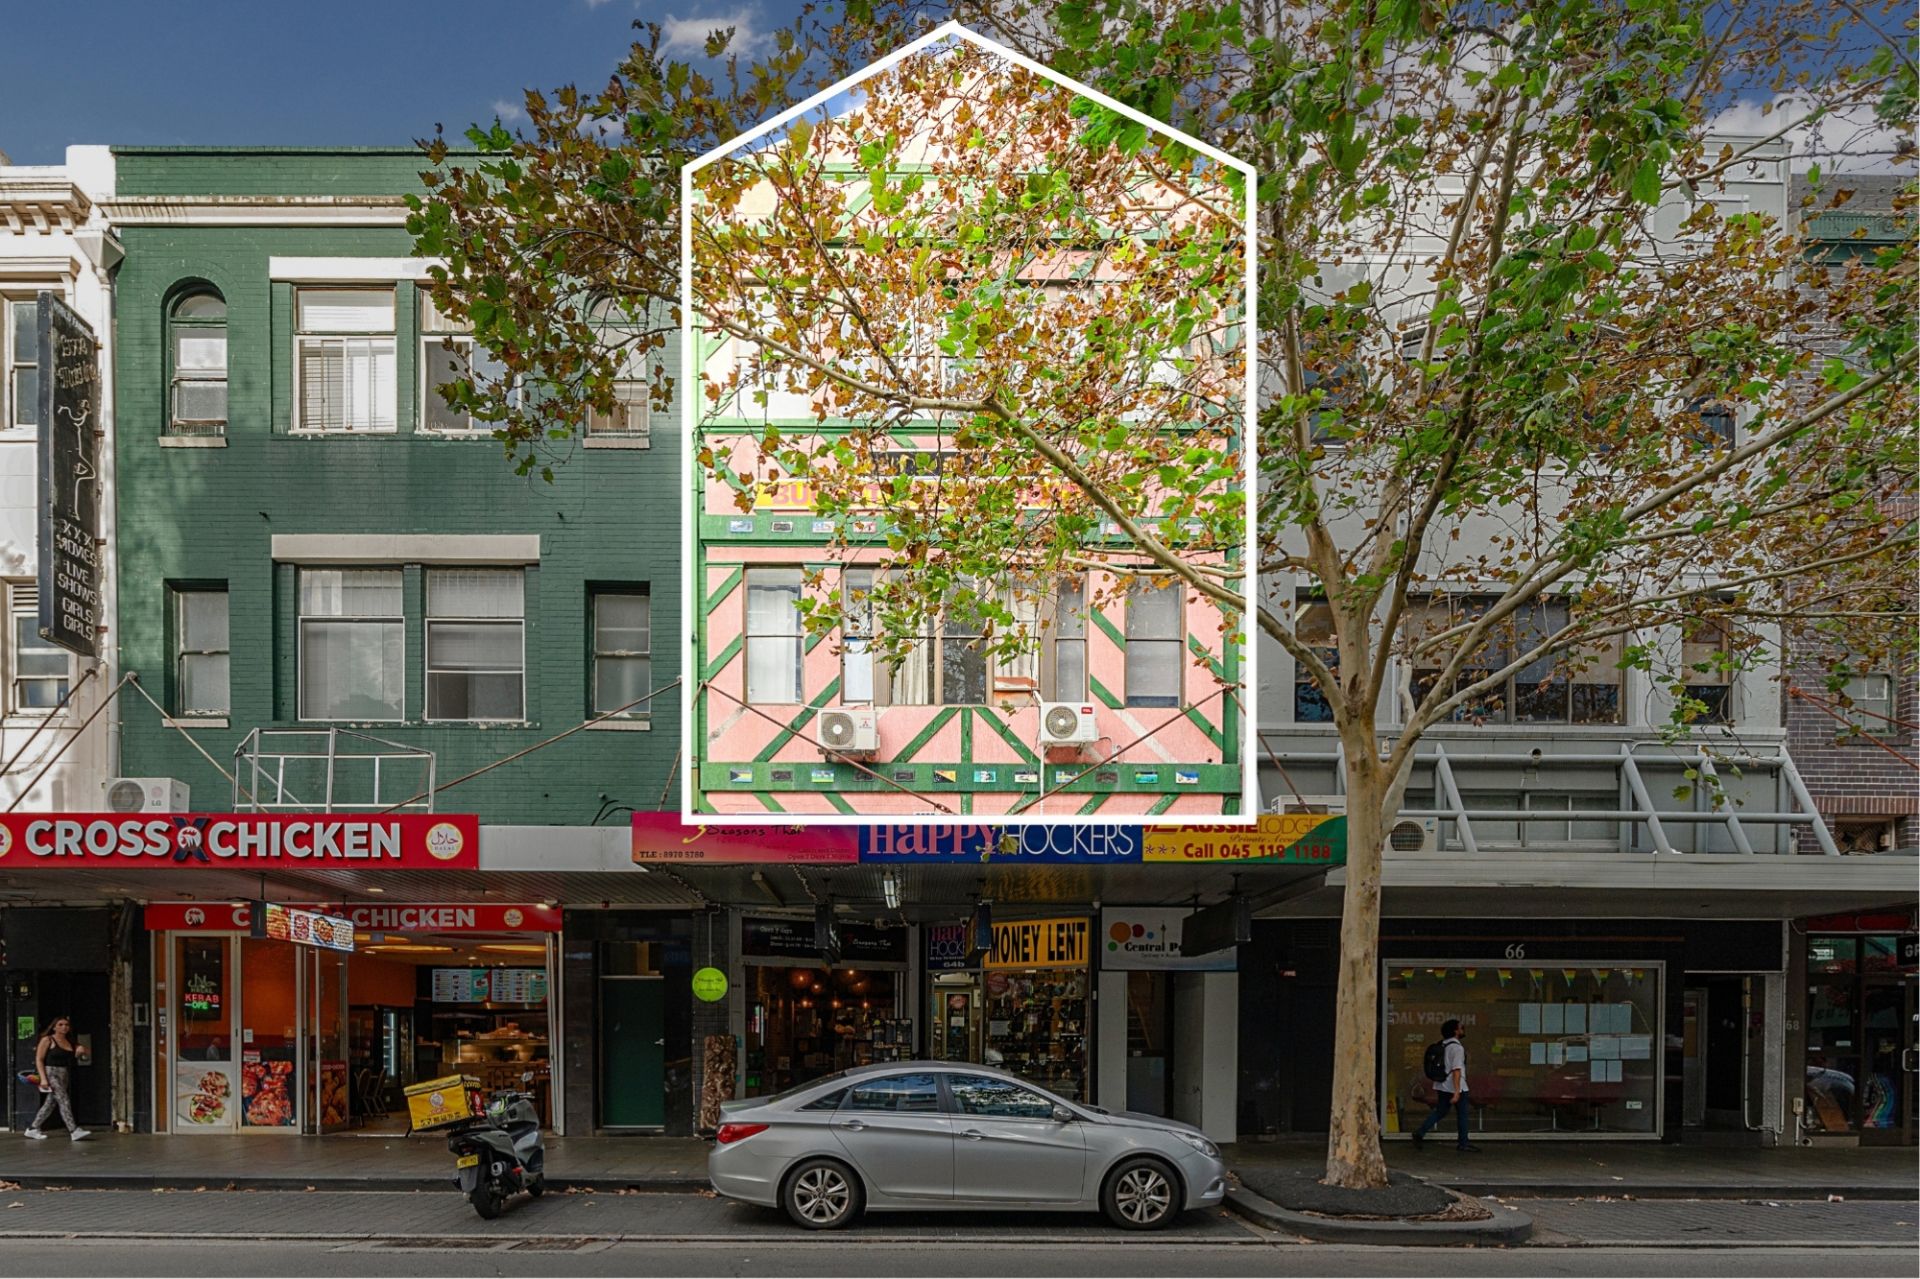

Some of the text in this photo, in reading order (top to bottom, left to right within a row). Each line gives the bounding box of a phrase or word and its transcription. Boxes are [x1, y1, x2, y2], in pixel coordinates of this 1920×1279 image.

[65, 560, 88, 585] LIVE
[57, 573, 97, 605] SHOWS
[62, 597, 94, 624] GIRLS
[63, 615, 94, 641] GIRLS
[1258, 817, 1320, 834] LODGE
[25, 820, 171, 857] CROSS
[208, 822, 401, 858] CHICKEN
[1183, 843, 1213, 858] Call
[1220, 844, 1250, 859] 045
[352, 908, 476, 927] CHICKEN
[930, 940, 966, 956] HOCK
[989, 922, 1086, 963] MONEY LENT
[1125, 942, 1165, 952] Central
[1505, 944, 1525, 959] 66
[184, 993, 220, 1003] KEBAB
